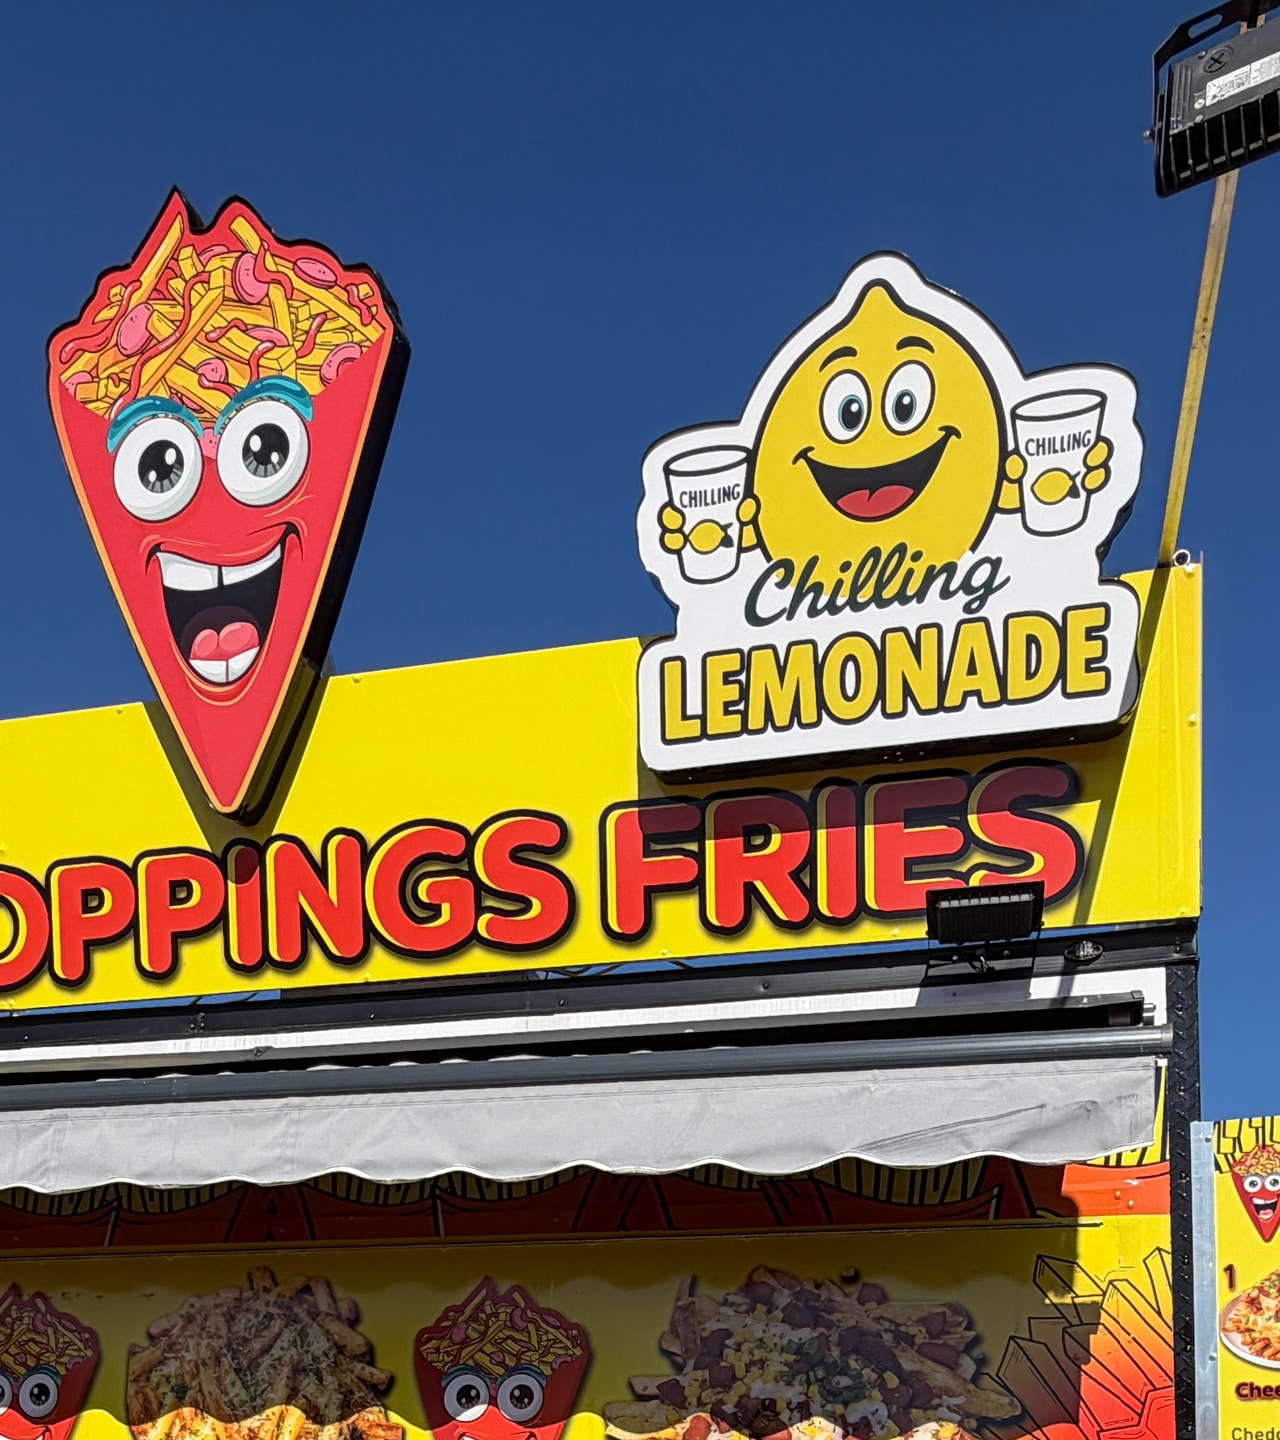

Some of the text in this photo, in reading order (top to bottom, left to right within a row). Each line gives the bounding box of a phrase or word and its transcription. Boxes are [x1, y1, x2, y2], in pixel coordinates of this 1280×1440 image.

[1024, 429, 1092, 458] CHILLING
[679, 483, 740, 509] CHILLING
[745, 542, 1010, 627] Chilling
[659, 602, 1113, 746] LEMONADE
[599, 758, 1084, 941] FRIES
[1223, 1264, 1235, 1290] 1
